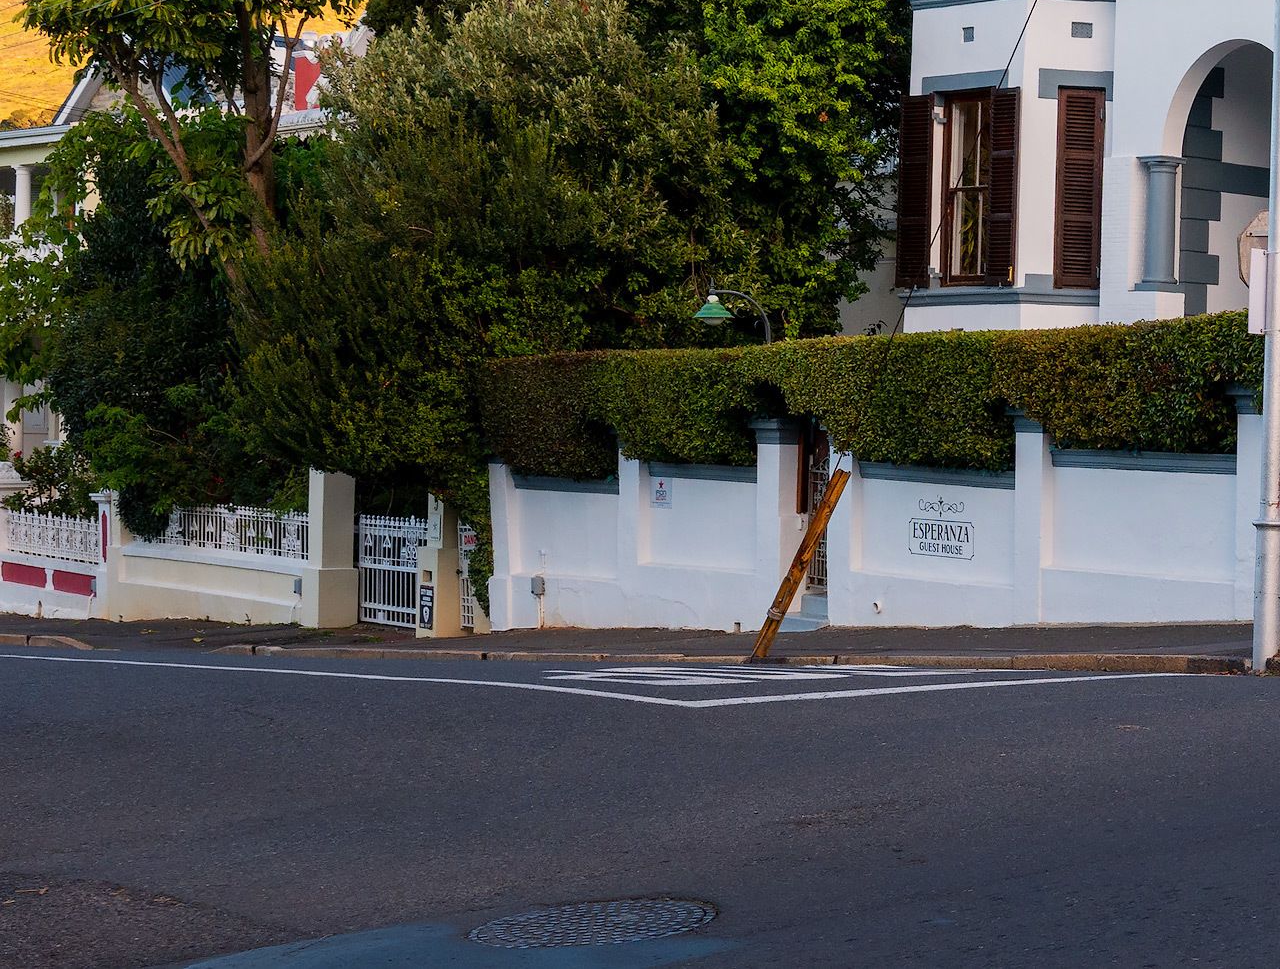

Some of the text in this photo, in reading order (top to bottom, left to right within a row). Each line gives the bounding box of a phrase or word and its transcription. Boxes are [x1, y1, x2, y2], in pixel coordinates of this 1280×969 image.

[913, 522, 969, 543] ESPERANZA
[919, 541, 963, 555] GUEST HOUSE
